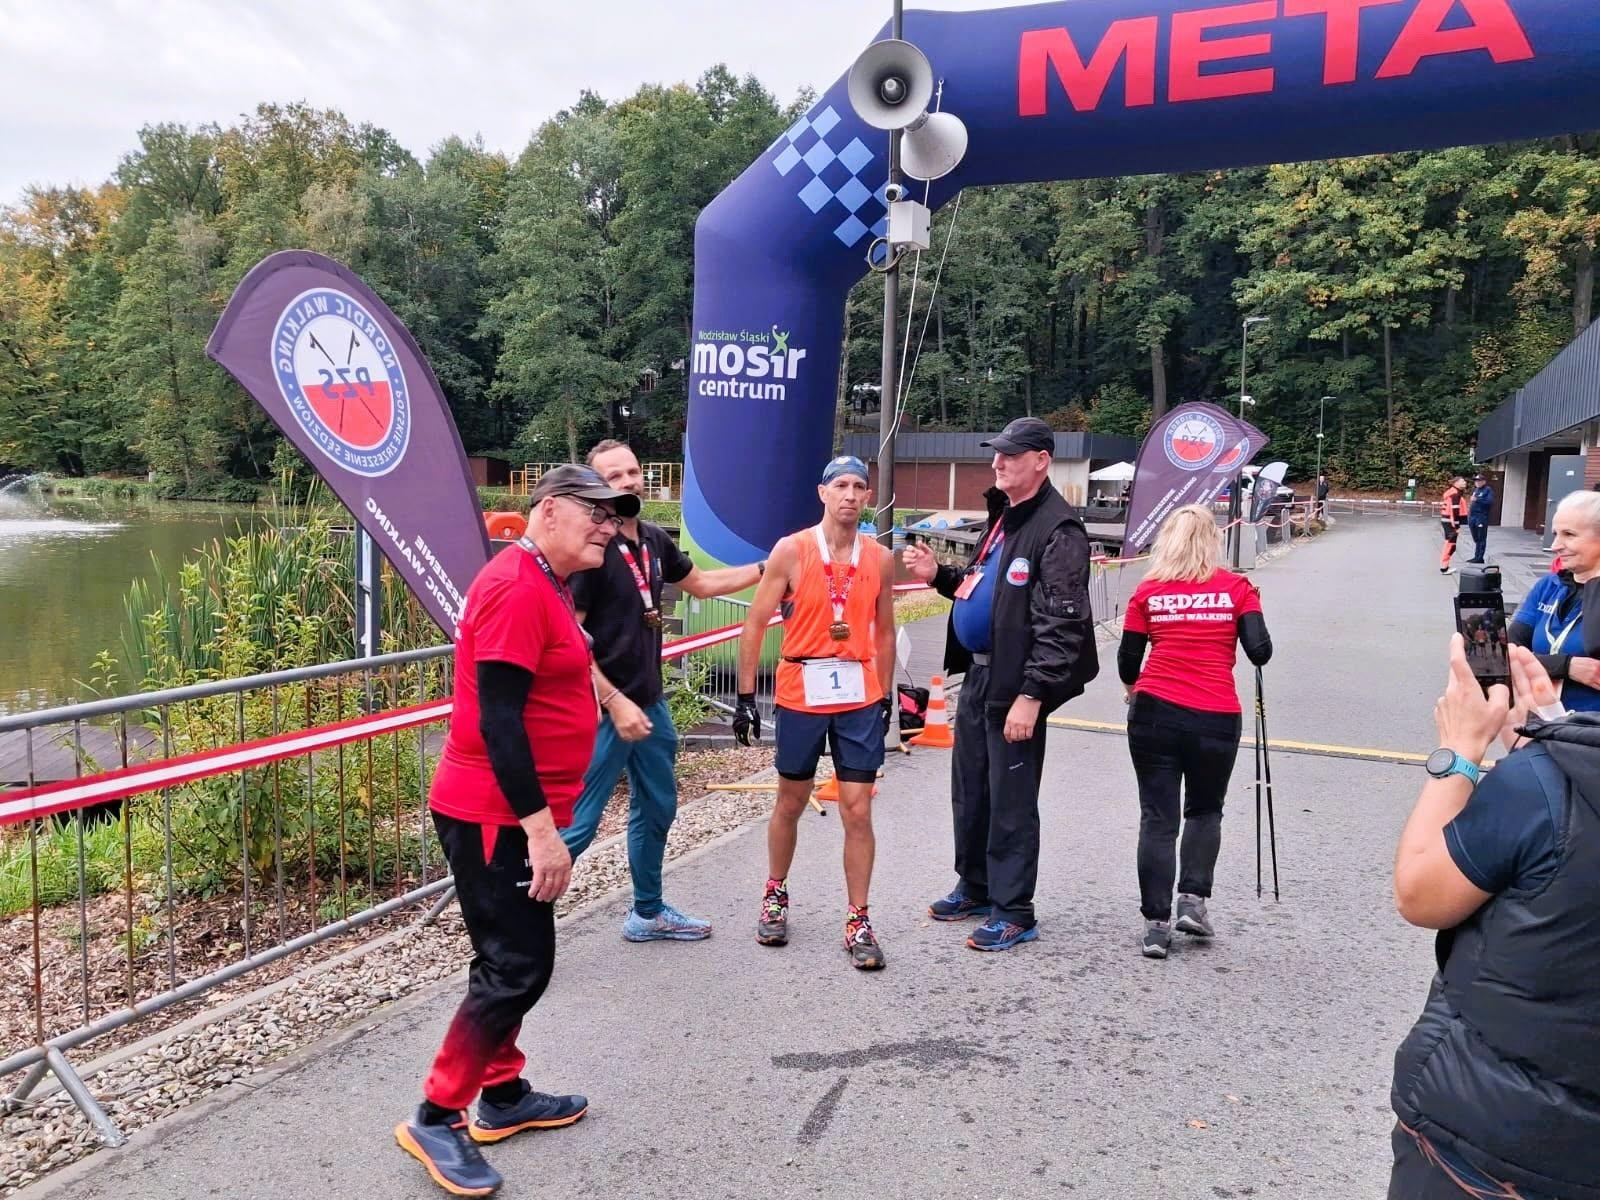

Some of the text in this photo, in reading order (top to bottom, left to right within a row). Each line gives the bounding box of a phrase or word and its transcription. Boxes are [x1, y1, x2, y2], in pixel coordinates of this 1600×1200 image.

[1018, 0, 1535, 117] META
[740, 329, 770, 344] Śląski
[693, 342, 807, 380] mosir
[698, 377, 786, 401] centrum
[1172, 476, 1198, 503] WALKING
[1147, 592, 1235, 614] SĘDZIA
[1150, 613, 1233, 623] NORDIC WALKING
[829, 670, 842, 690] 1
